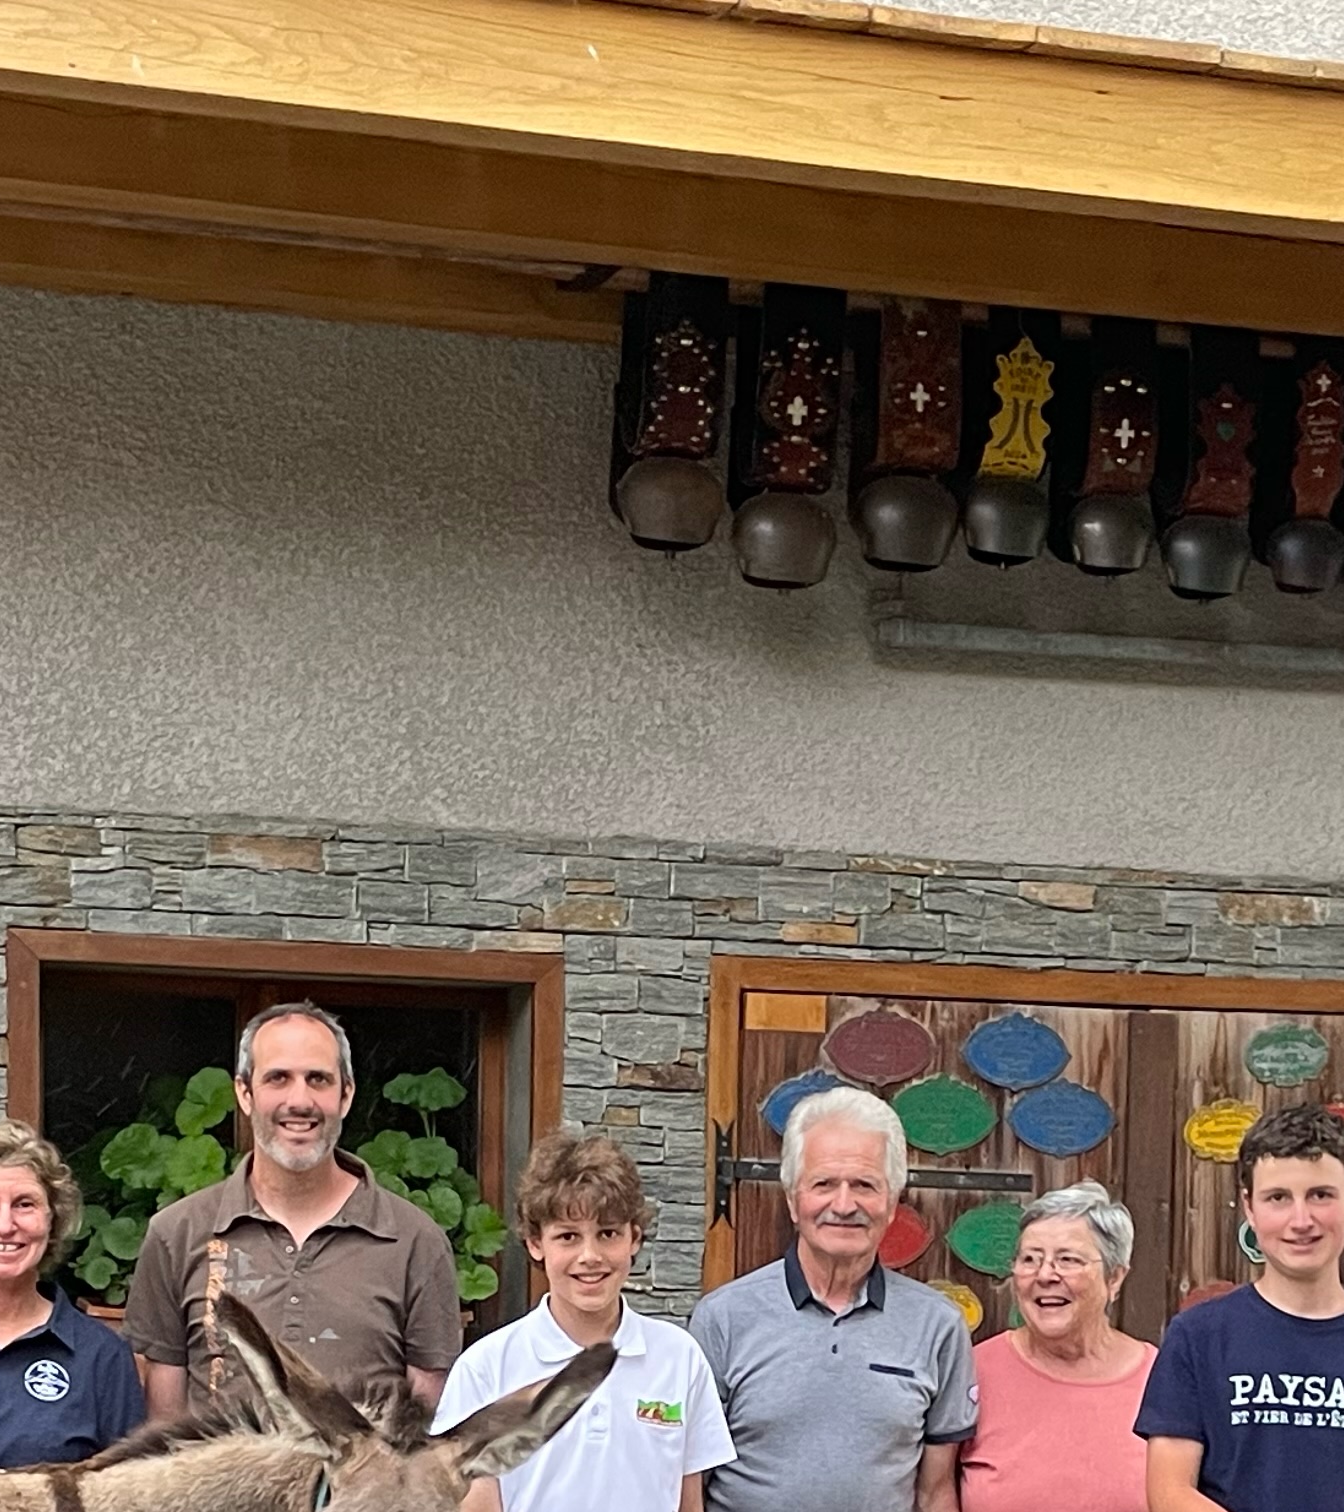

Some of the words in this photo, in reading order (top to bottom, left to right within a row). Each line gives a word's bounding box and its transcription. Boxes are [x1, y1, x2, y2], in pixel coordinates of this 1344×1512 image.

[1231, 1410, 1250, 1425] ET
[1254, 1409, 1290, 1424] FIER
[1294, 1412, 1313, 1426] DE
